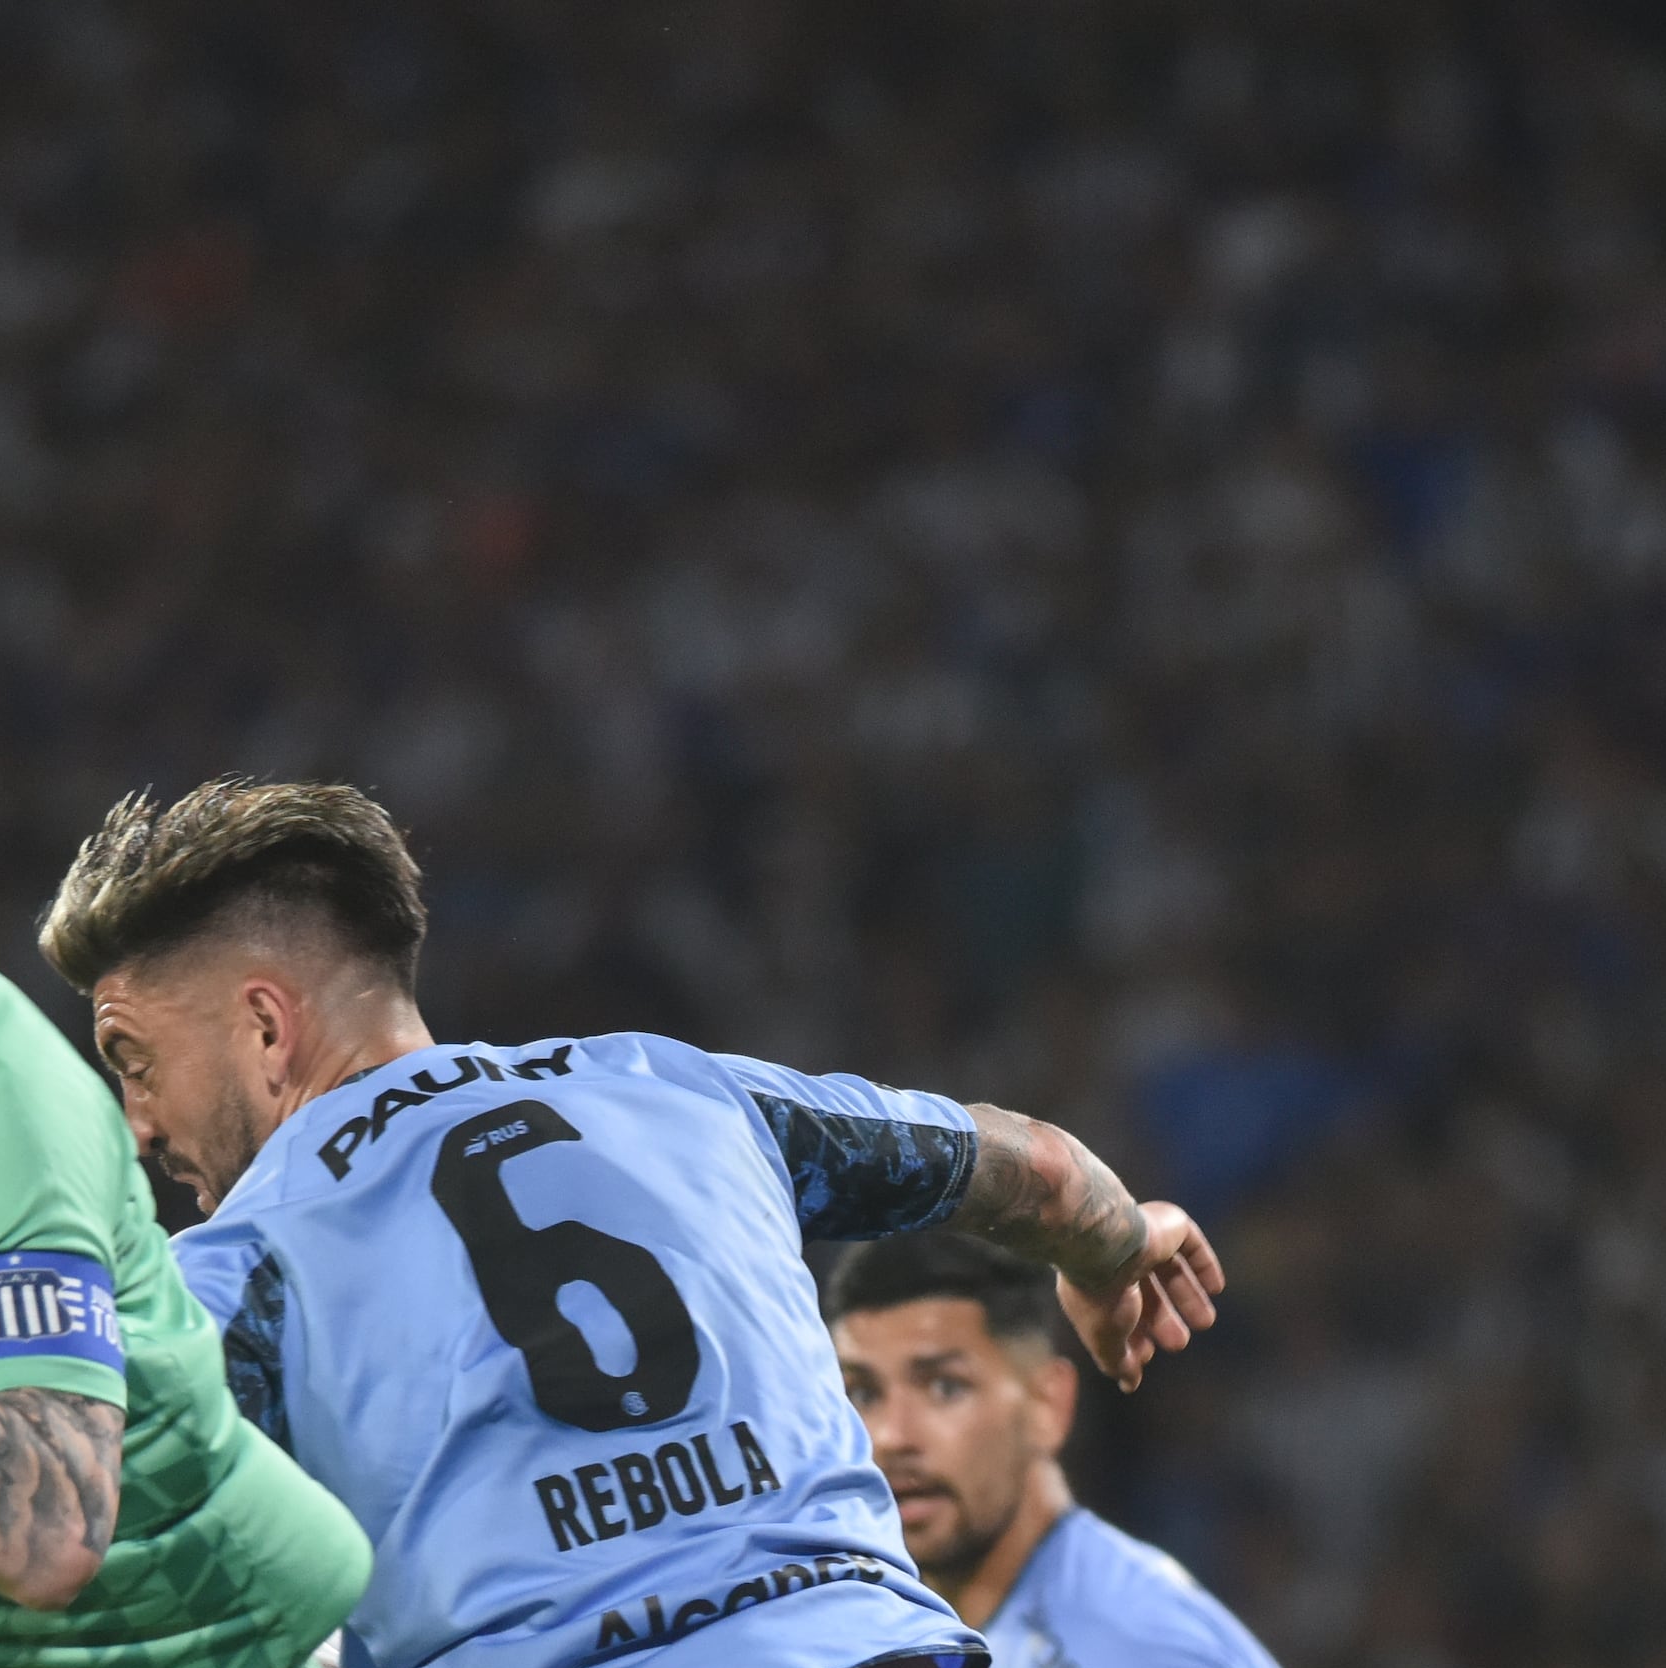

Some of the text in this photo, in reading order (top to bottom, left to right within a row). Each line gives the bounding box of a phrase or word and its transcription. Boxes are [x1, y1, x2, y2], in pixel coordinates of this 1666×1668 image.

[318, 1045, 573, 1182] PAUNY
[490, 1119, 530, 1146] RUS
[432, 1099, 700, 1432] 6
[534, 1421, 781, 1552] REBOLA
